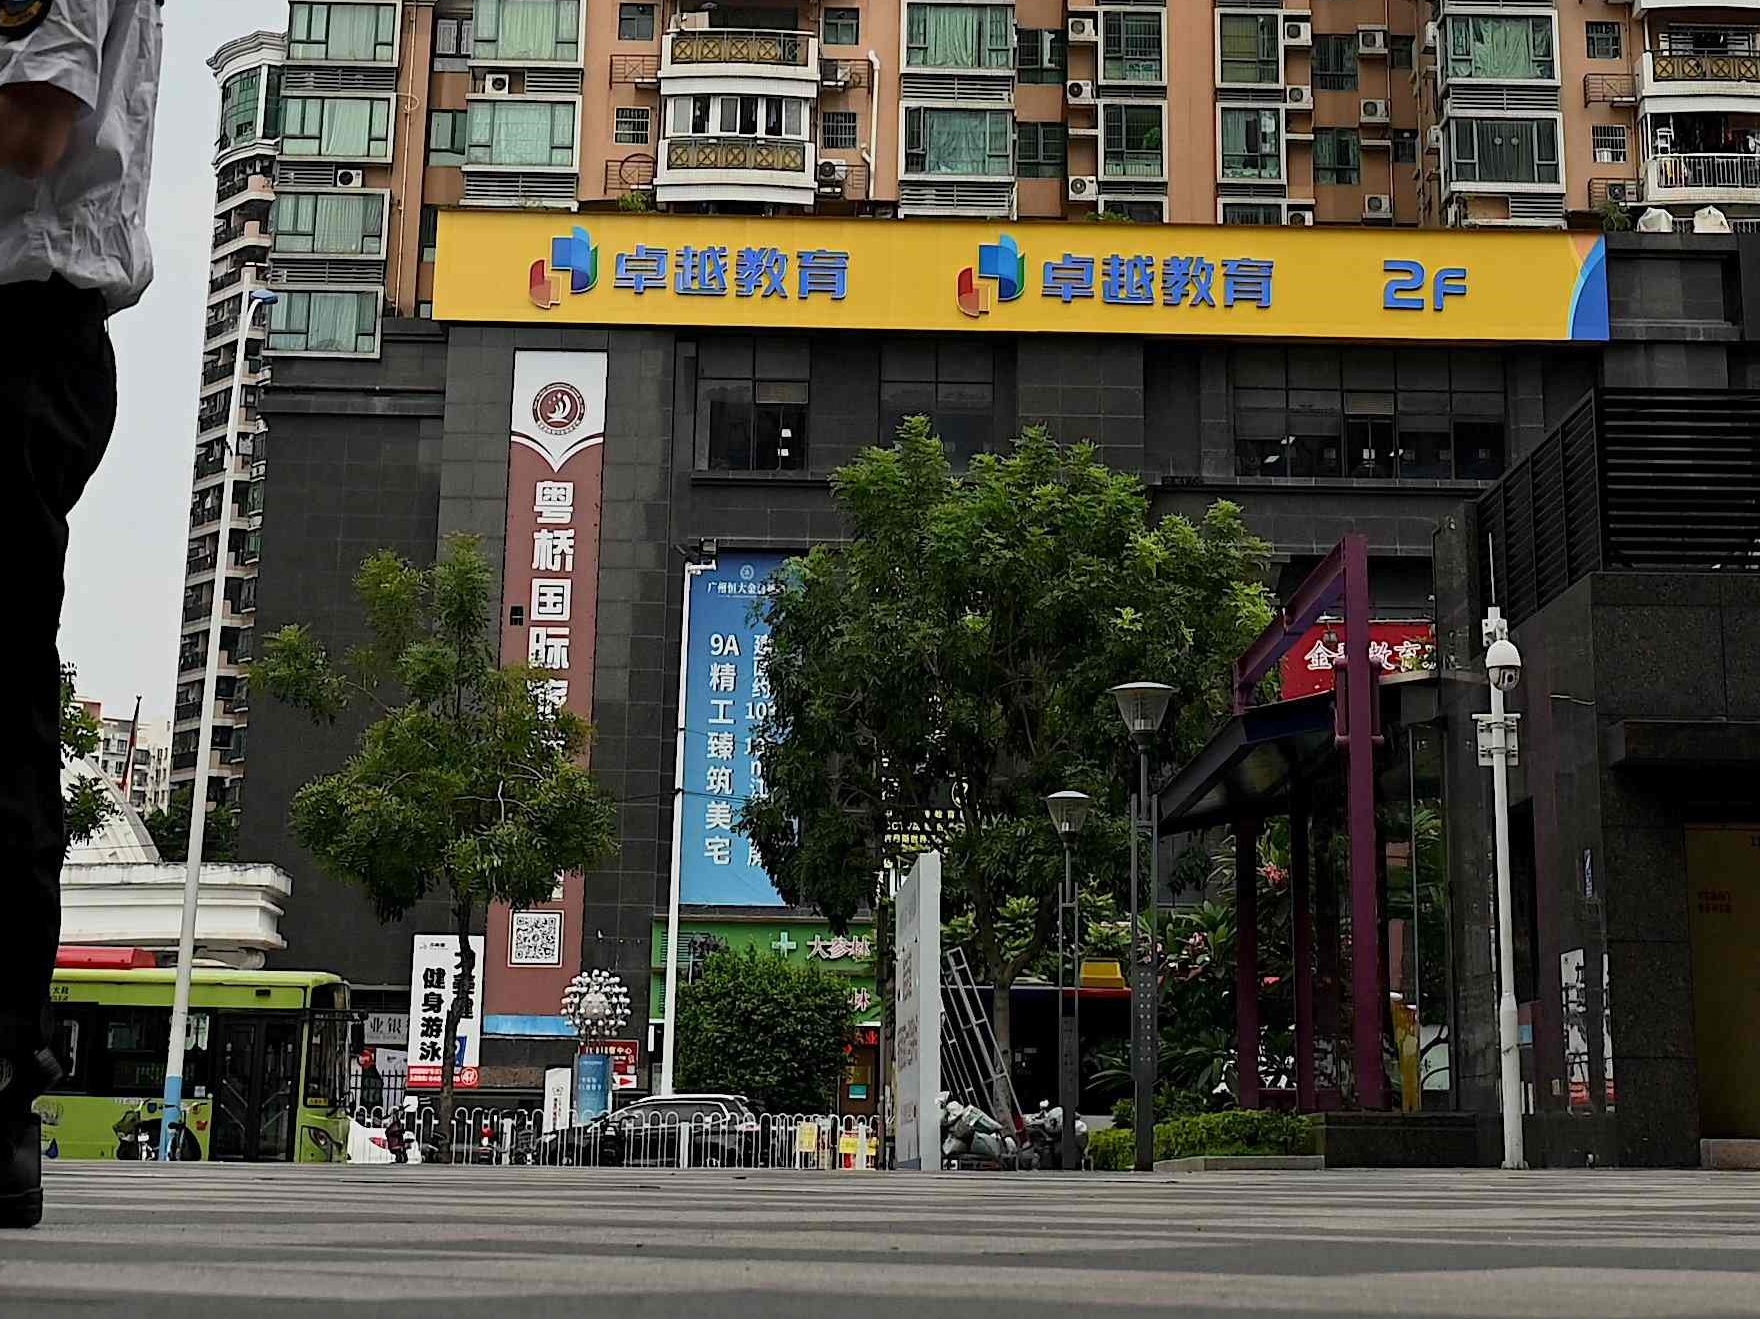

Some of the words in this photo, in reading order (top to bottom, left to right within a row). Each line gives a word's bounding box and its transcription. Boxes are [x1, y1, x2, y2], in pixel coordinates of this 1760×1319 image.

[614, 245, 849, 300] 卓越教育
[1042, 252, 1275, 307] 卓越教育
[1383, 259, 1468, 311] 2F
[419, 967, 446, 1062] 健身游泳
